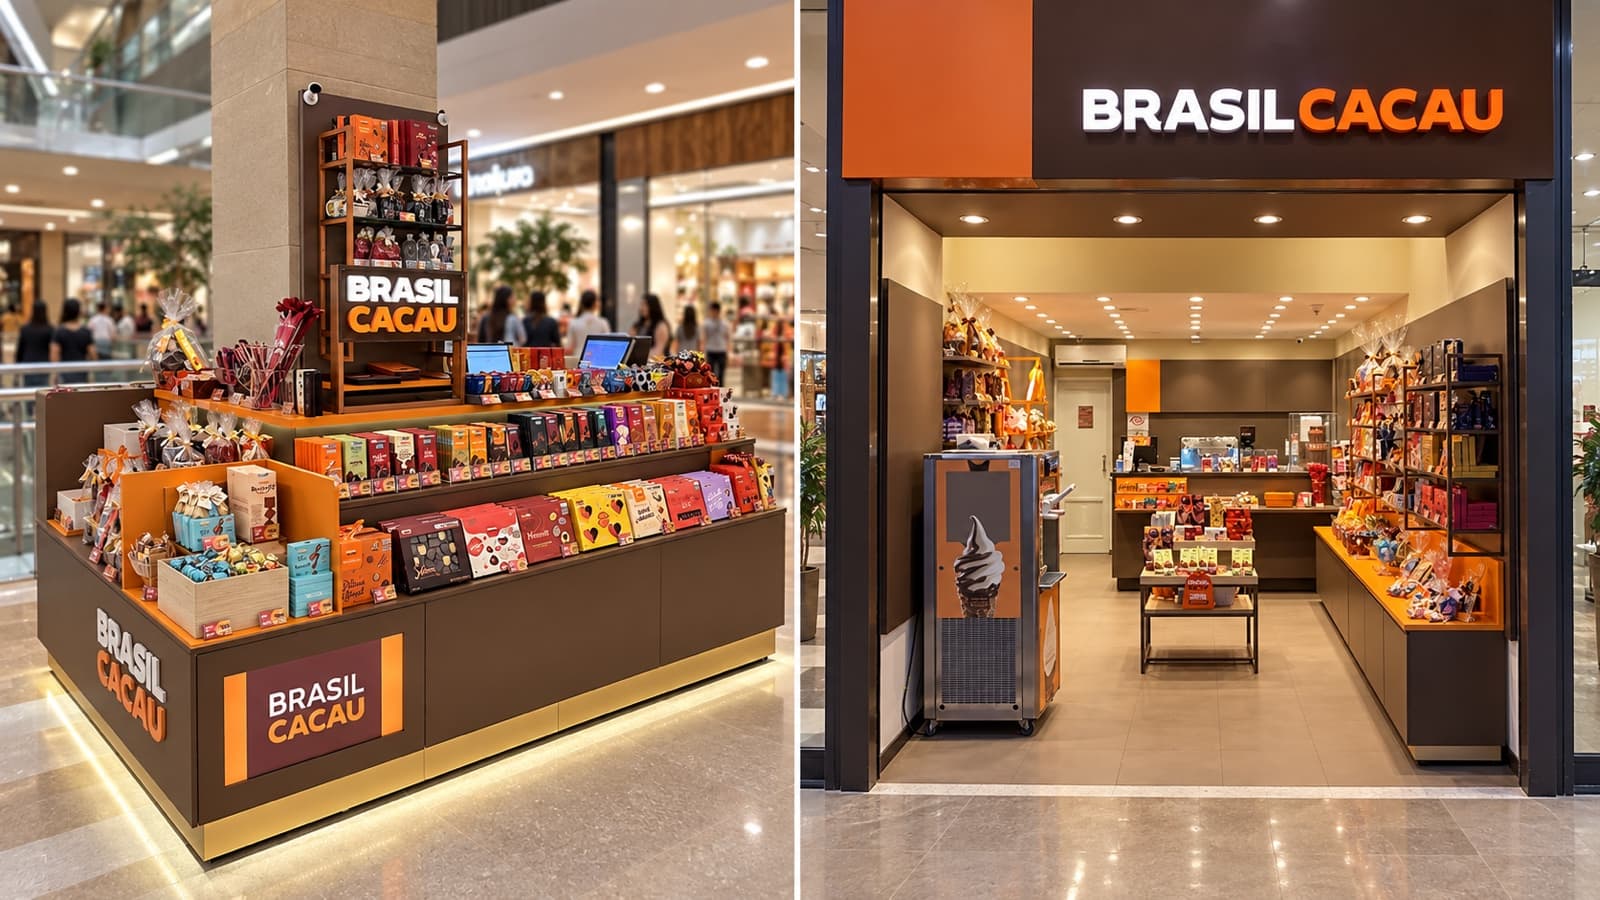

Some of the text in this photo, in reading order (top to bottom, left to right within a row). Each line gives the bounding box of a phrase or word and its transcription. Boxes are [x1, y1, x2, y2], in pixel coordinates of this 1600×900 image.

[1082, 88, 1503, 134] BRASIL CACAU
[347, 275, 459, 304] BRASIL
[348, 306, 457, 333] CACAU
[97, 607, 167, 704] BRASIL
[96, 650, 167, 743] CACAU
[268, 673, 365, 718] BRASIL
[267, 697, 365, 744] CACAU
